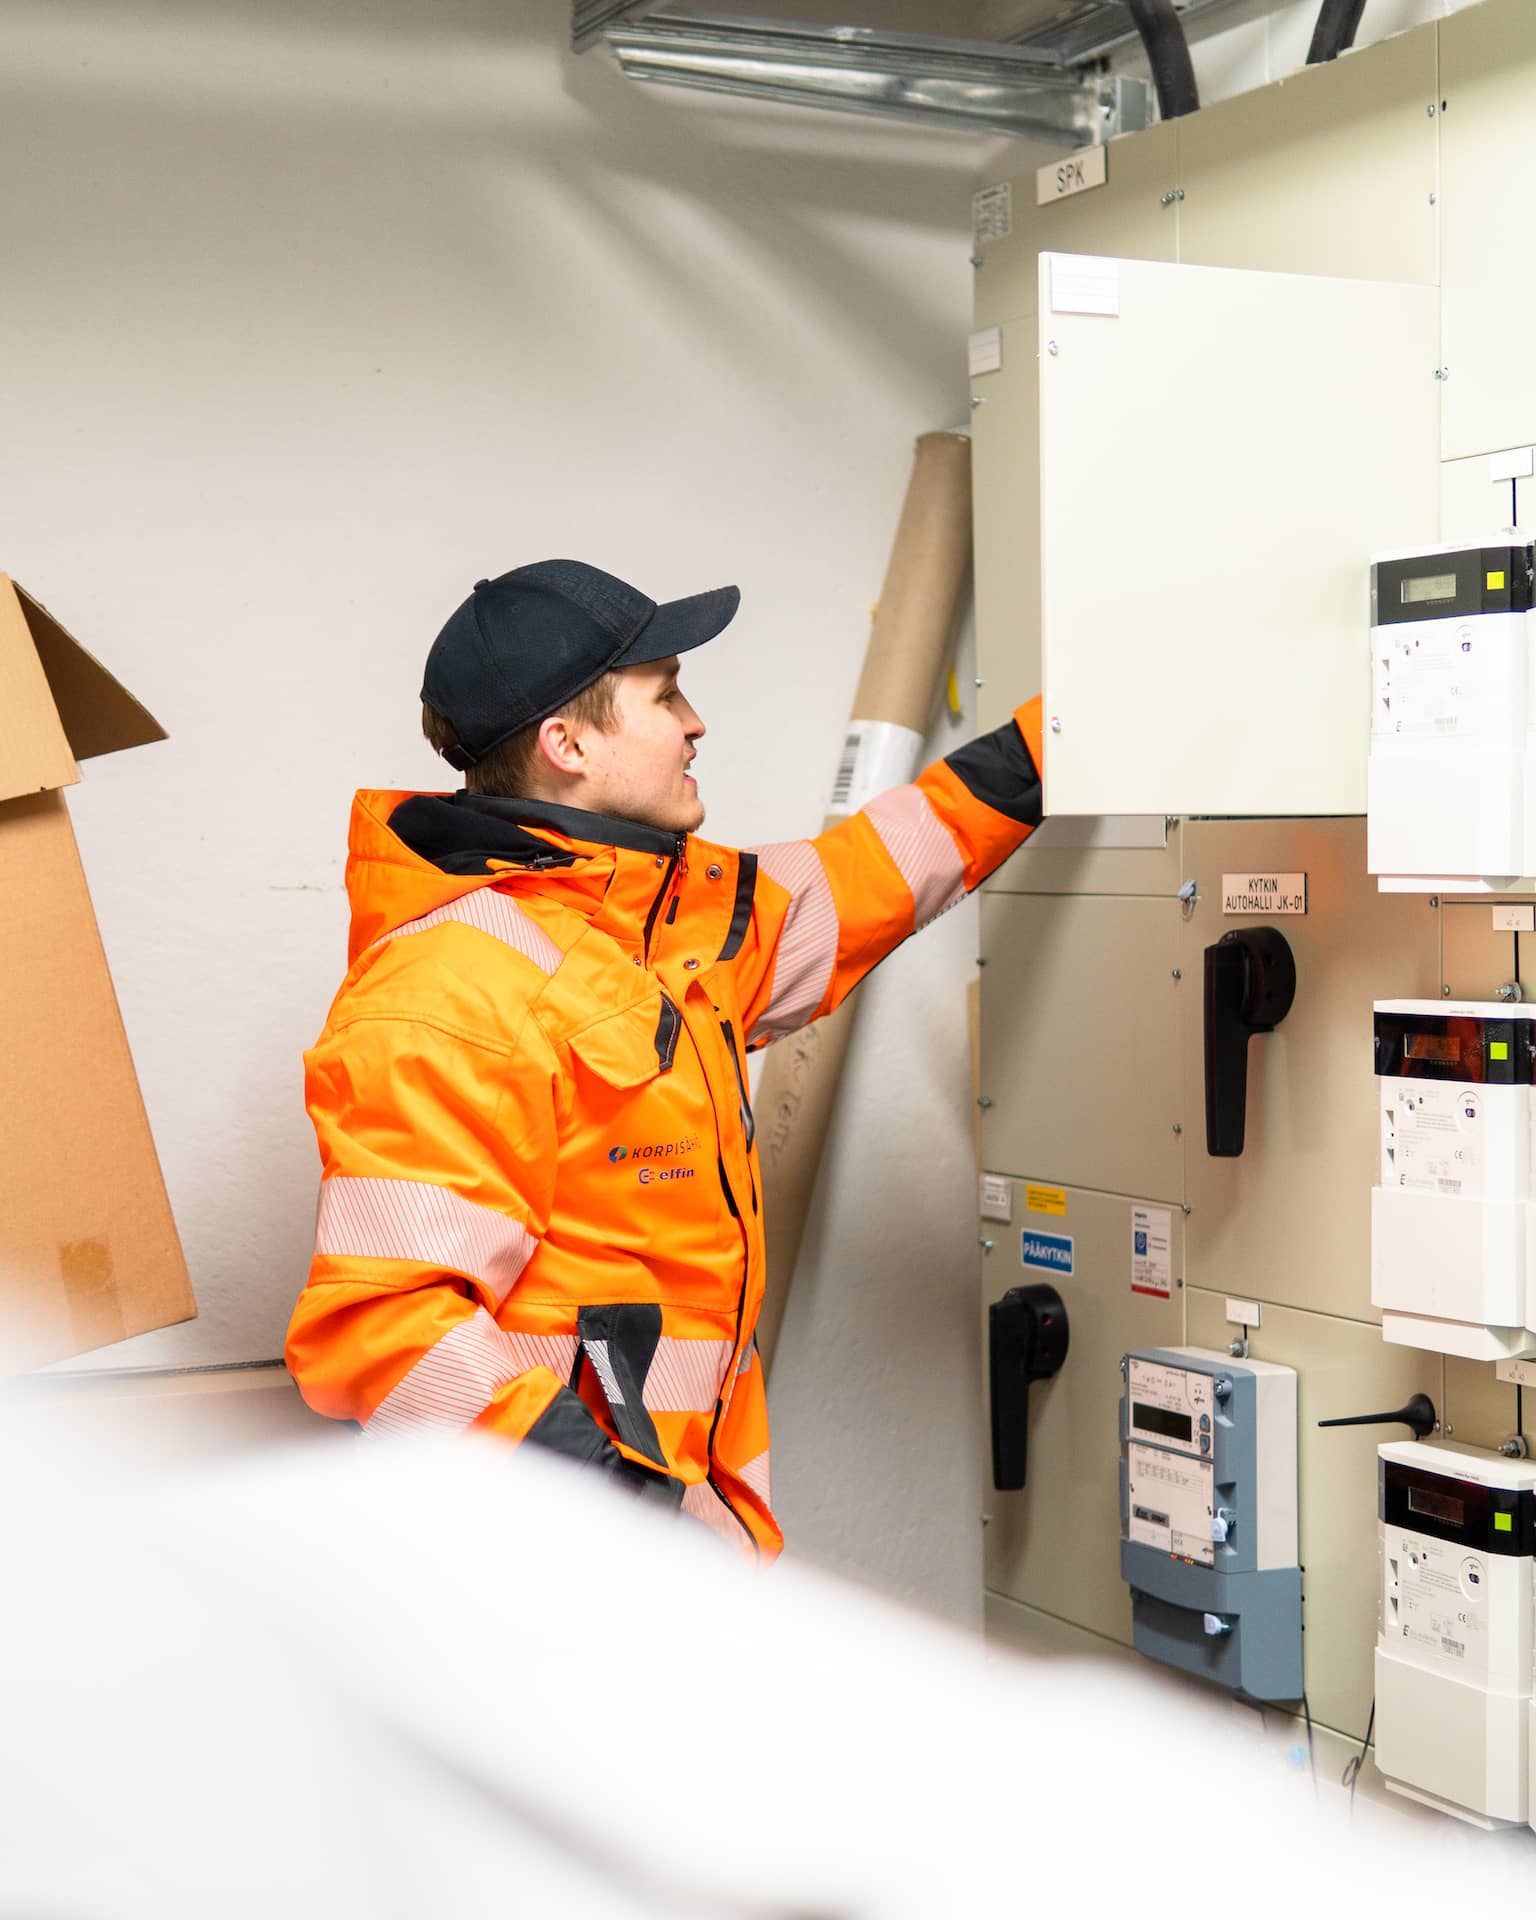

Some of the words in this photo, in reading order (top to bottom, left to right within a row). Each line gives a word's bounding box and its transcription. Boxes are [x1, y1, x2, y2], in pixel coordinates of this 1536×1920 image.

[1056, 160, 1084, 193] SPK
[1248, 879, 1278, 893] KYTKIN
[1226, 896, 1272, 910] AUTOHALLI
[1277, 896, 1303, 910] JK-01
[660, 1168, 694, 1180] elfin
[1023, 1240, 1072, 1265] PÄÄKYTKIN
